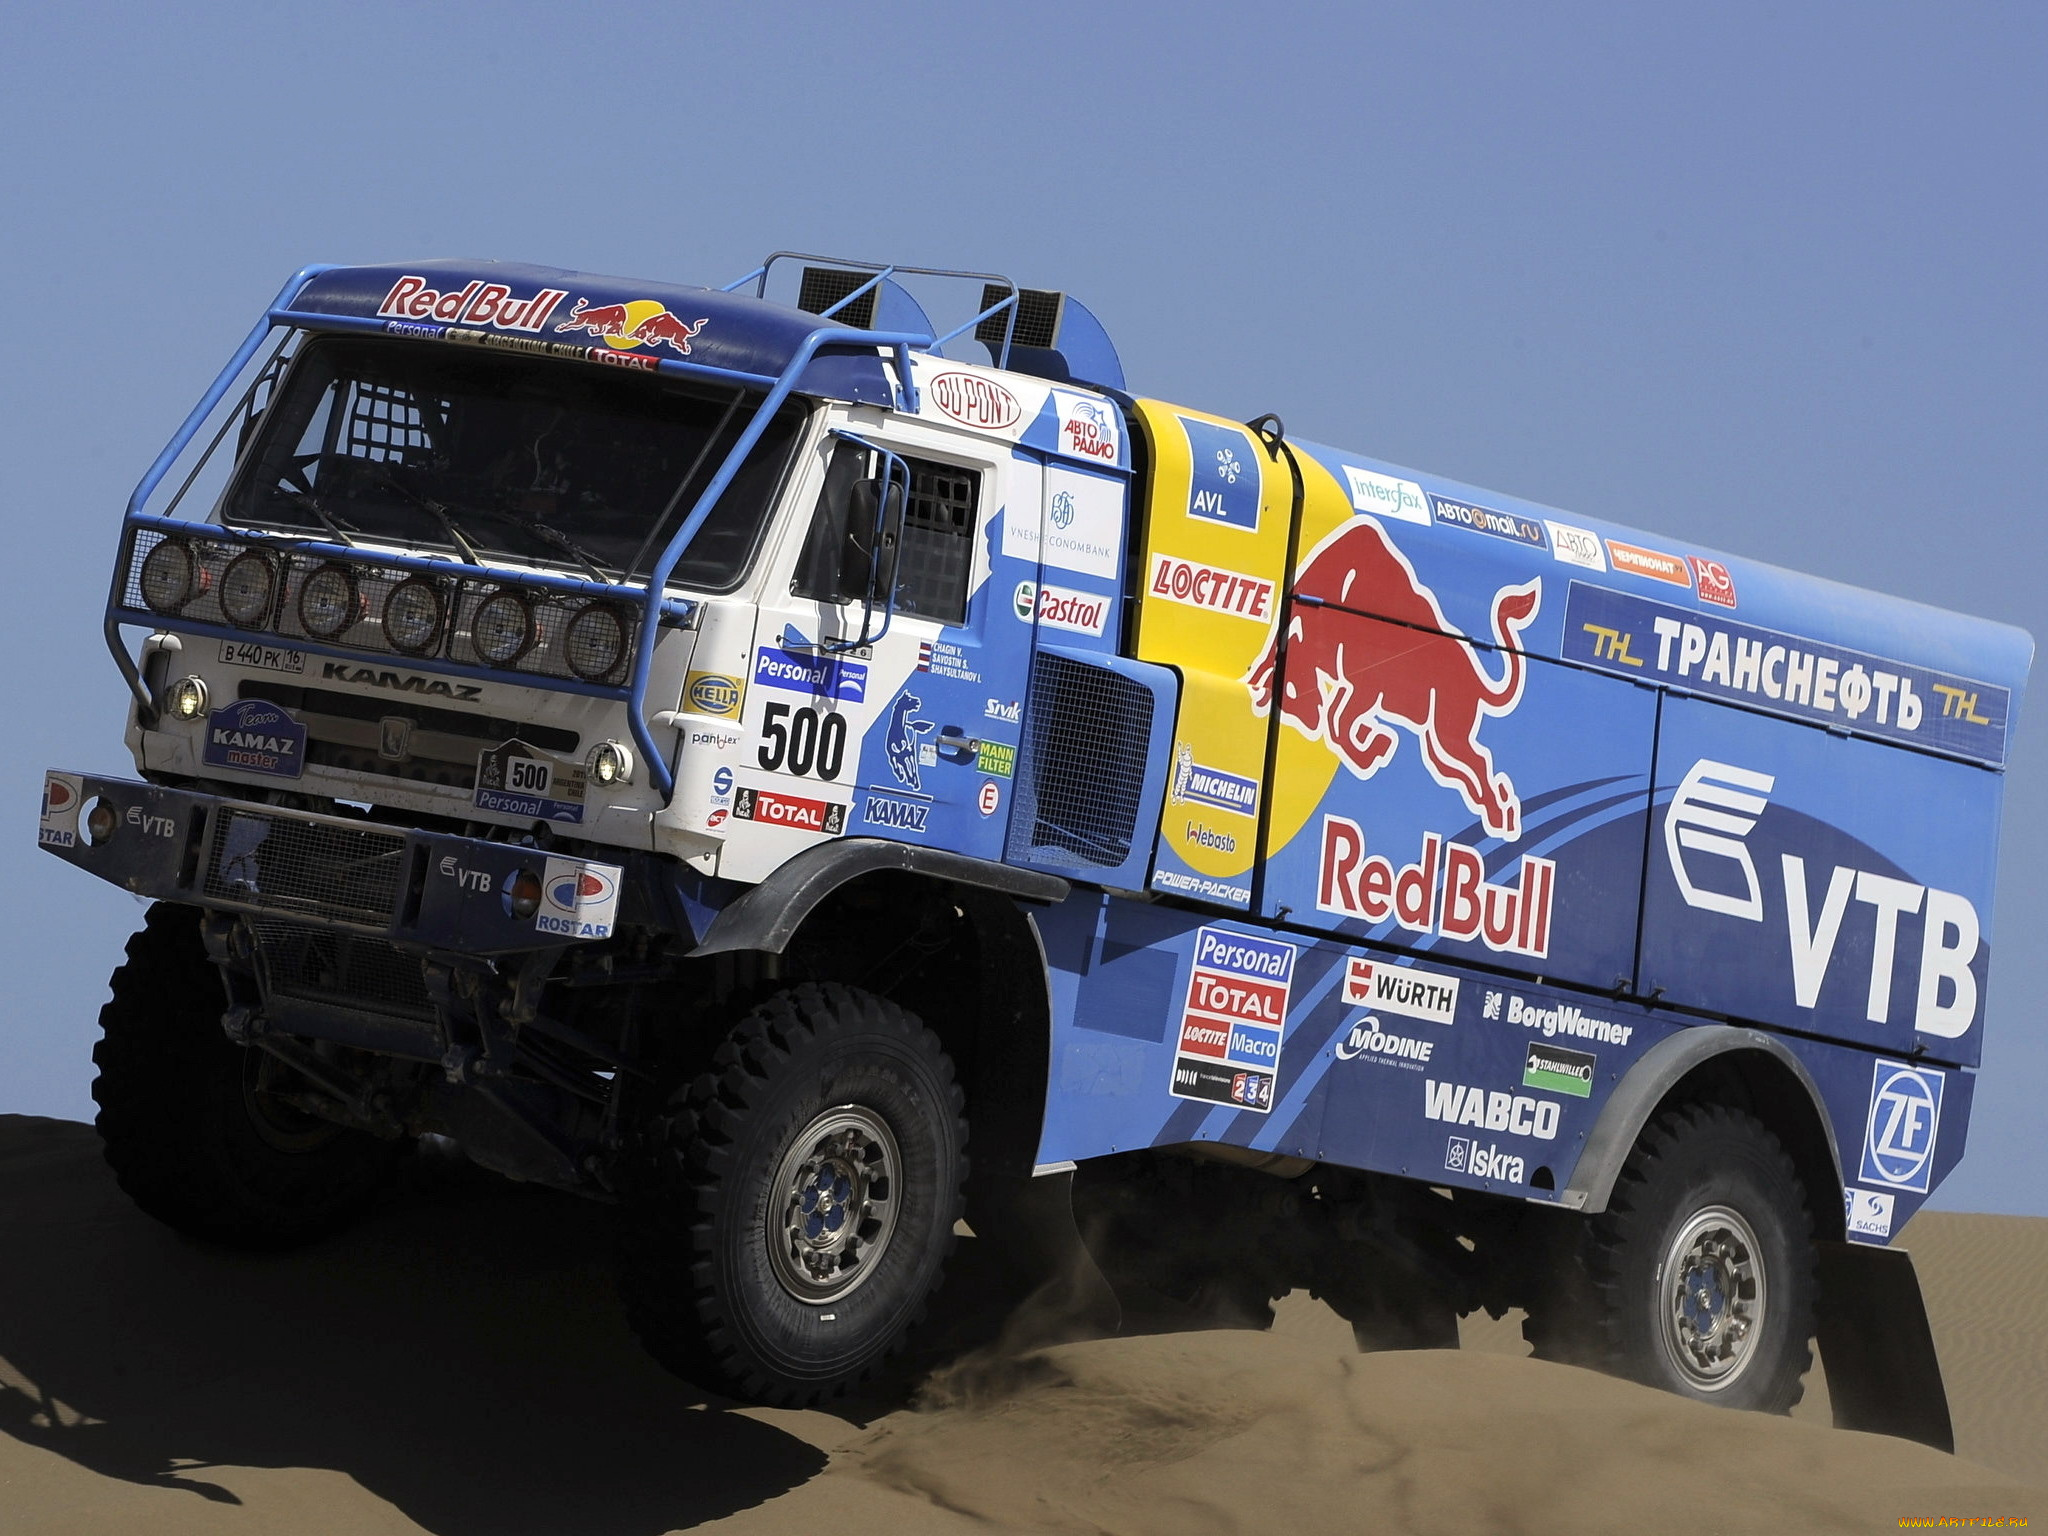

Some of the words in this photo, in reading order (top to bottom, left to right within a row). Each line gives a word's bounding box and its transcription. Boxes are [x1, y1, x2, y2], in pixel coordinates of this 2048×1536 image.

[387, 321, 443, 339] Personal
[595, 348, 655, 371] TOTAL
[1073, 436, 1114, 460] РАДИО
[1193, 489, 1227, 516] AVL
[1152, 559, 1271, 617] LOCTITE
[1039, 590, 1102, 629] Castrol
[322, 662, 483, 702] KAMAZ
[757, 655, 827, 685] Personal
[840, 669, 865, 680] Personal
[1653, 616, 1923, 731] ТРАНСНЕФТЬ
[693, 686, 739, 707] HELLA
[237, 703, 279, 728] Team
[213, 728, 294, 754] KAMAZ
[757, 700, 847, 782] 500
[979, 742, 1014, 762] MANN
[227, 749, 278, 769] master
[977, 756, 1012, 775] FILTER
[512, 762, 548, 791] 500
[1191, 773, 1256, 805] MICHELIN
[478, 791, 542, 815] Personal
[758, 796, 821, 826] TOTAL
[982, 788, 995, 809] E
[143, 814, 175, 838] VTB
[864, 796, 930, 833] KAMAZ
[458, 868, 491, 892] VTB
[1152, 870, 1252, 903] POWER-PACKER
[538, 915, 609, 937] ROSTAR
[1200, 934, 1291, 977] Personal
[1780, 852, 1981, 1039] VTB
[1196, 975, 1279, 1020] TOTAL
[1507, 996, 1633, 1046] BorgWarner
[1184, 1025, 1228, 1046] LOCTITE
[1231, 1033, 1276, 1057] Macro
[1349, 1028, 1434, 1062] MODINE
[1425, 1079, 1561, 1140] WABCO
[1876, 1091, 1932, 1162] ZF
[1468, 1141, 1525, 1184] Iskra
[1856, 1220, 1888, 1234] SACHS
